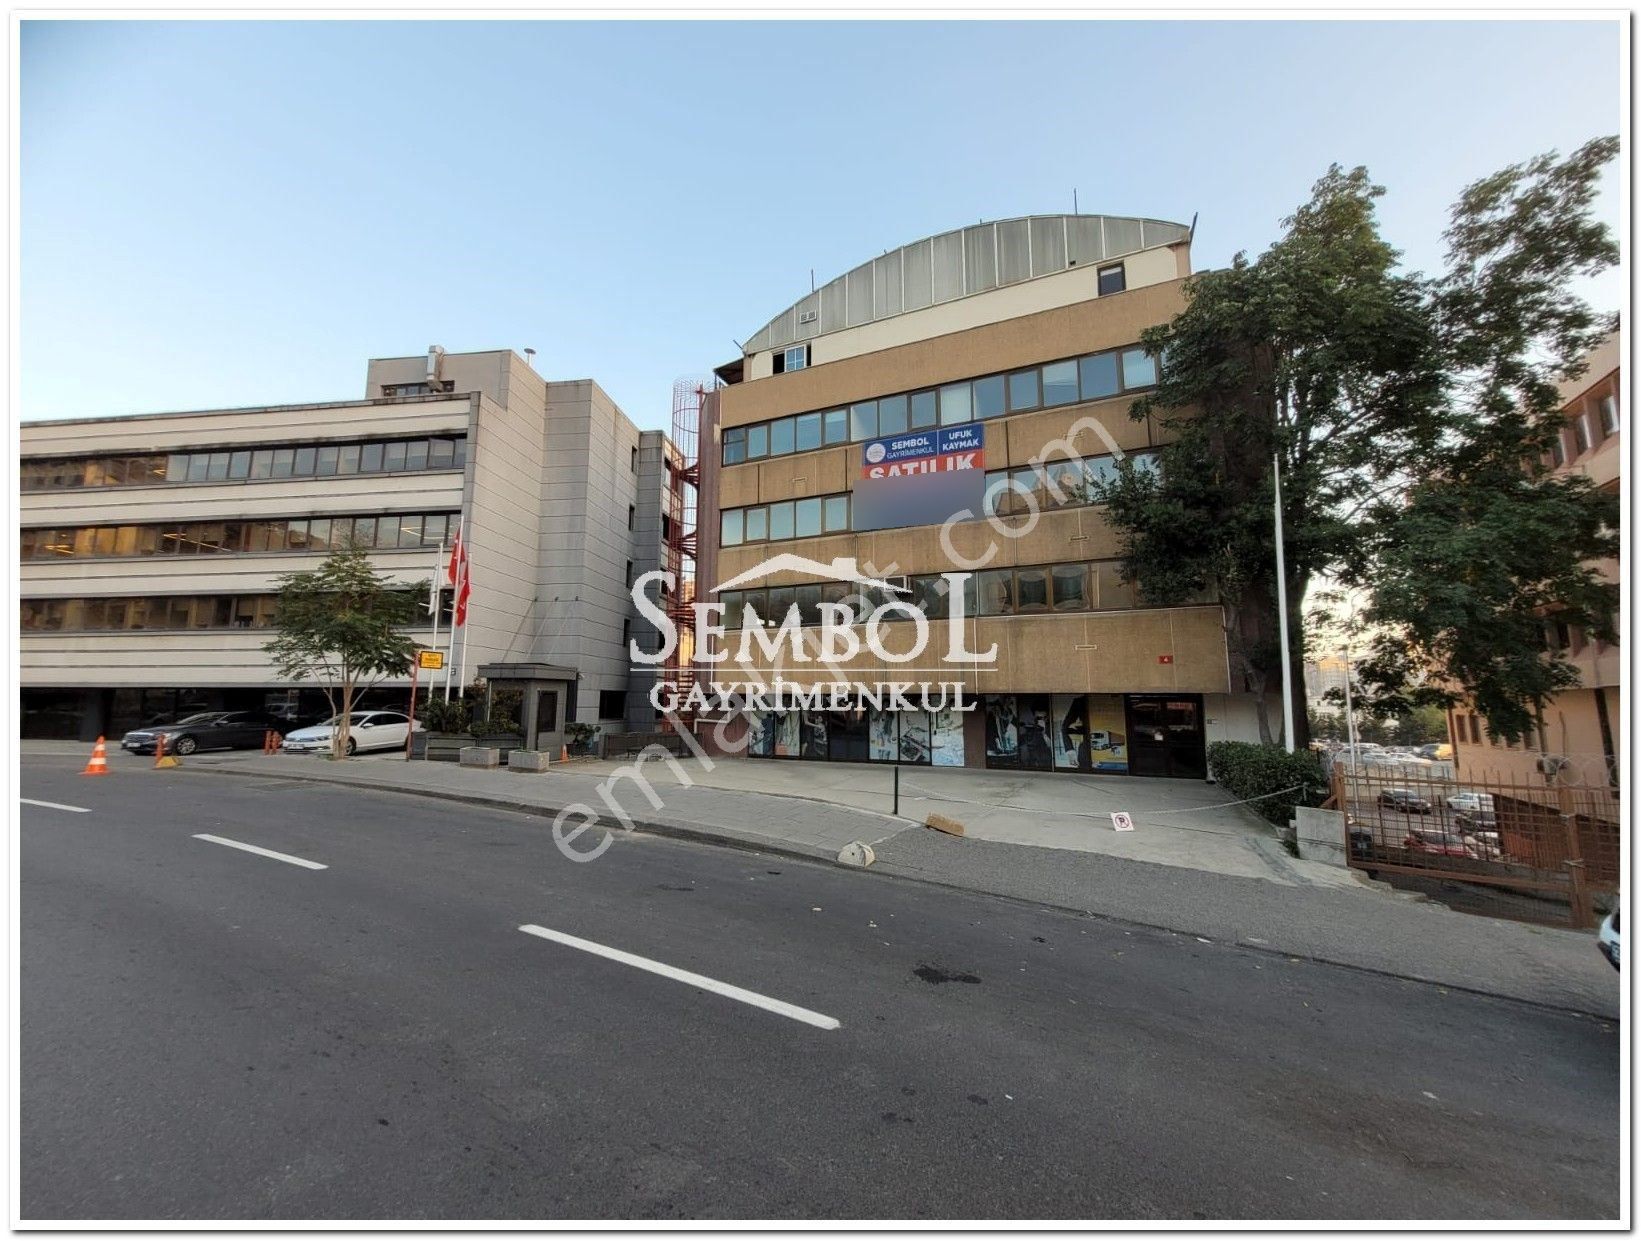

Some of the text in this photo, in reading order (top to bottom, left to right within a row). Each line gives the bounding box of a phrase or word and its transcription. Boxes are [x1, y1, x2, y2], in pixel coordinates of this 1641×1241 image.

[948, 429, 973, 440] UFUK
[891, 437, 930, 450] SEMBOL
[942, 438, 980, 452] KAYMAK
